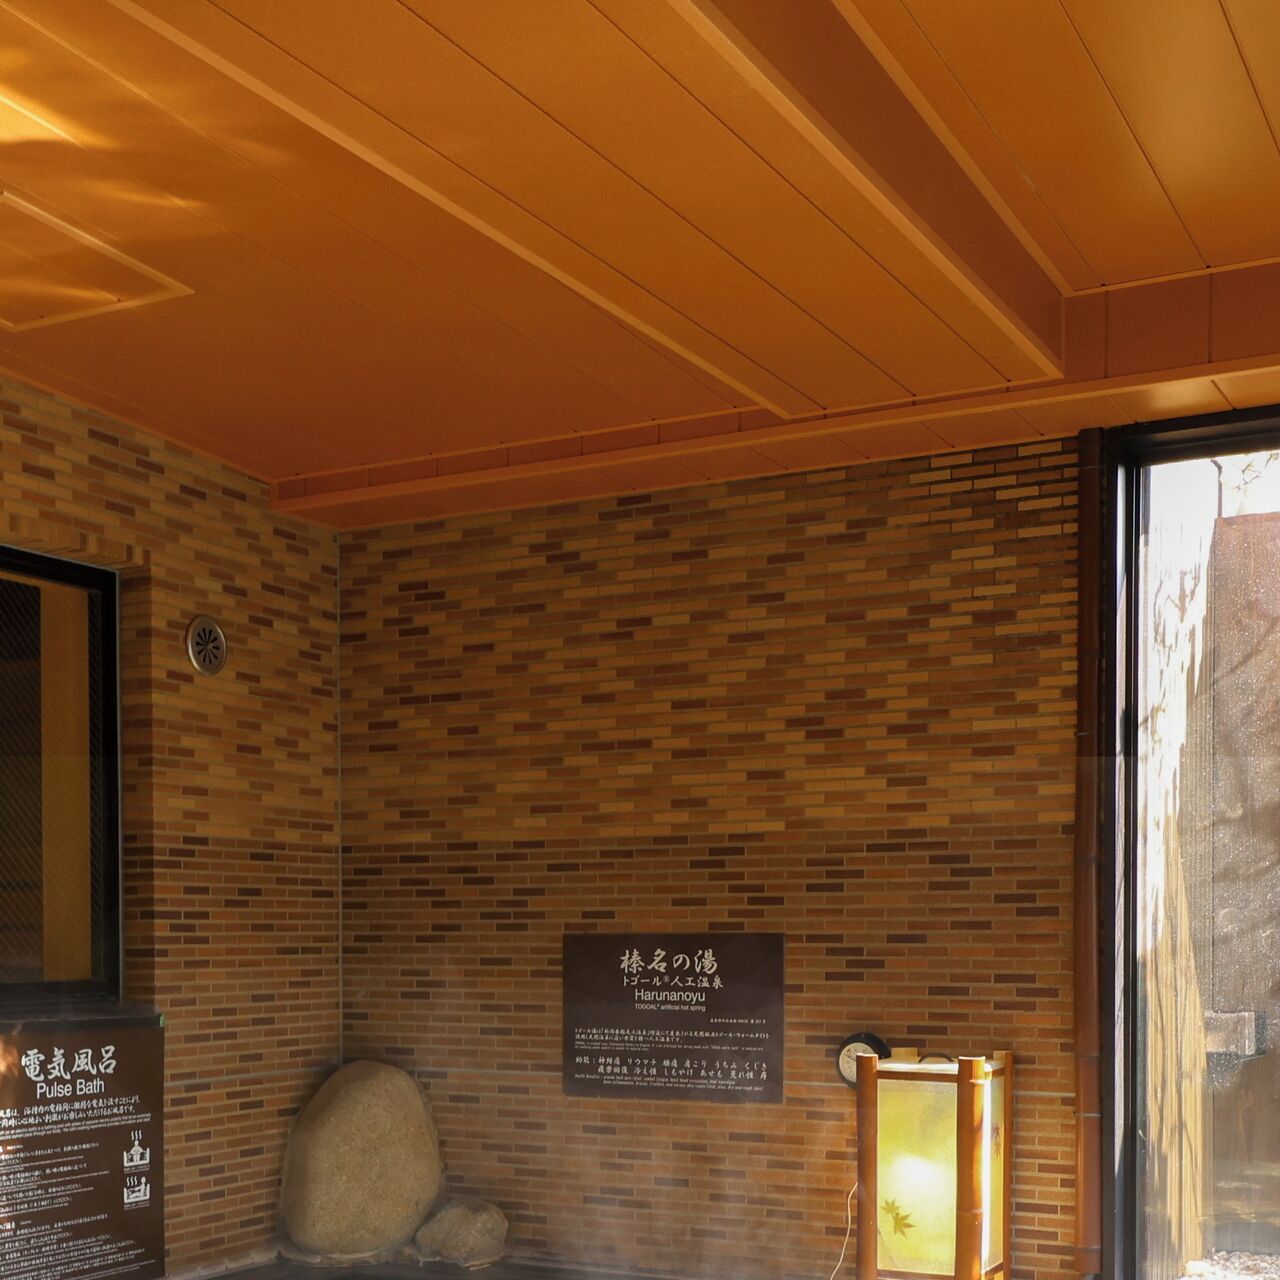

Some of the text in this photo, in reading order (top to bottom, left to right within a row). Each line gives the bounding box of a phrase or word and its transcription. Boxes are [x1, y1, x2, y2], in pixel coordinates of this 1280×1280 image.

[619, 947, 718, 975] 榛名の湯
[635, 988, 705, 1004] Harunanoyu
[690, 1005, 706, 1013] spring
[21, 1045, 117, 1082] 電気風呂
[627, 1058, 656, 1066] リウマチ
[684, 1059, 706, 1068] 肩こり
[715, 1060, 737, 1069] うちみ
[745, 1061, 767, 1071] くじき
[664, 1067, 693, 1078] しもやけ
[700, 1069, 723, 1078] あせも
[36, 1078, 105, 1099] Pulse Bath
